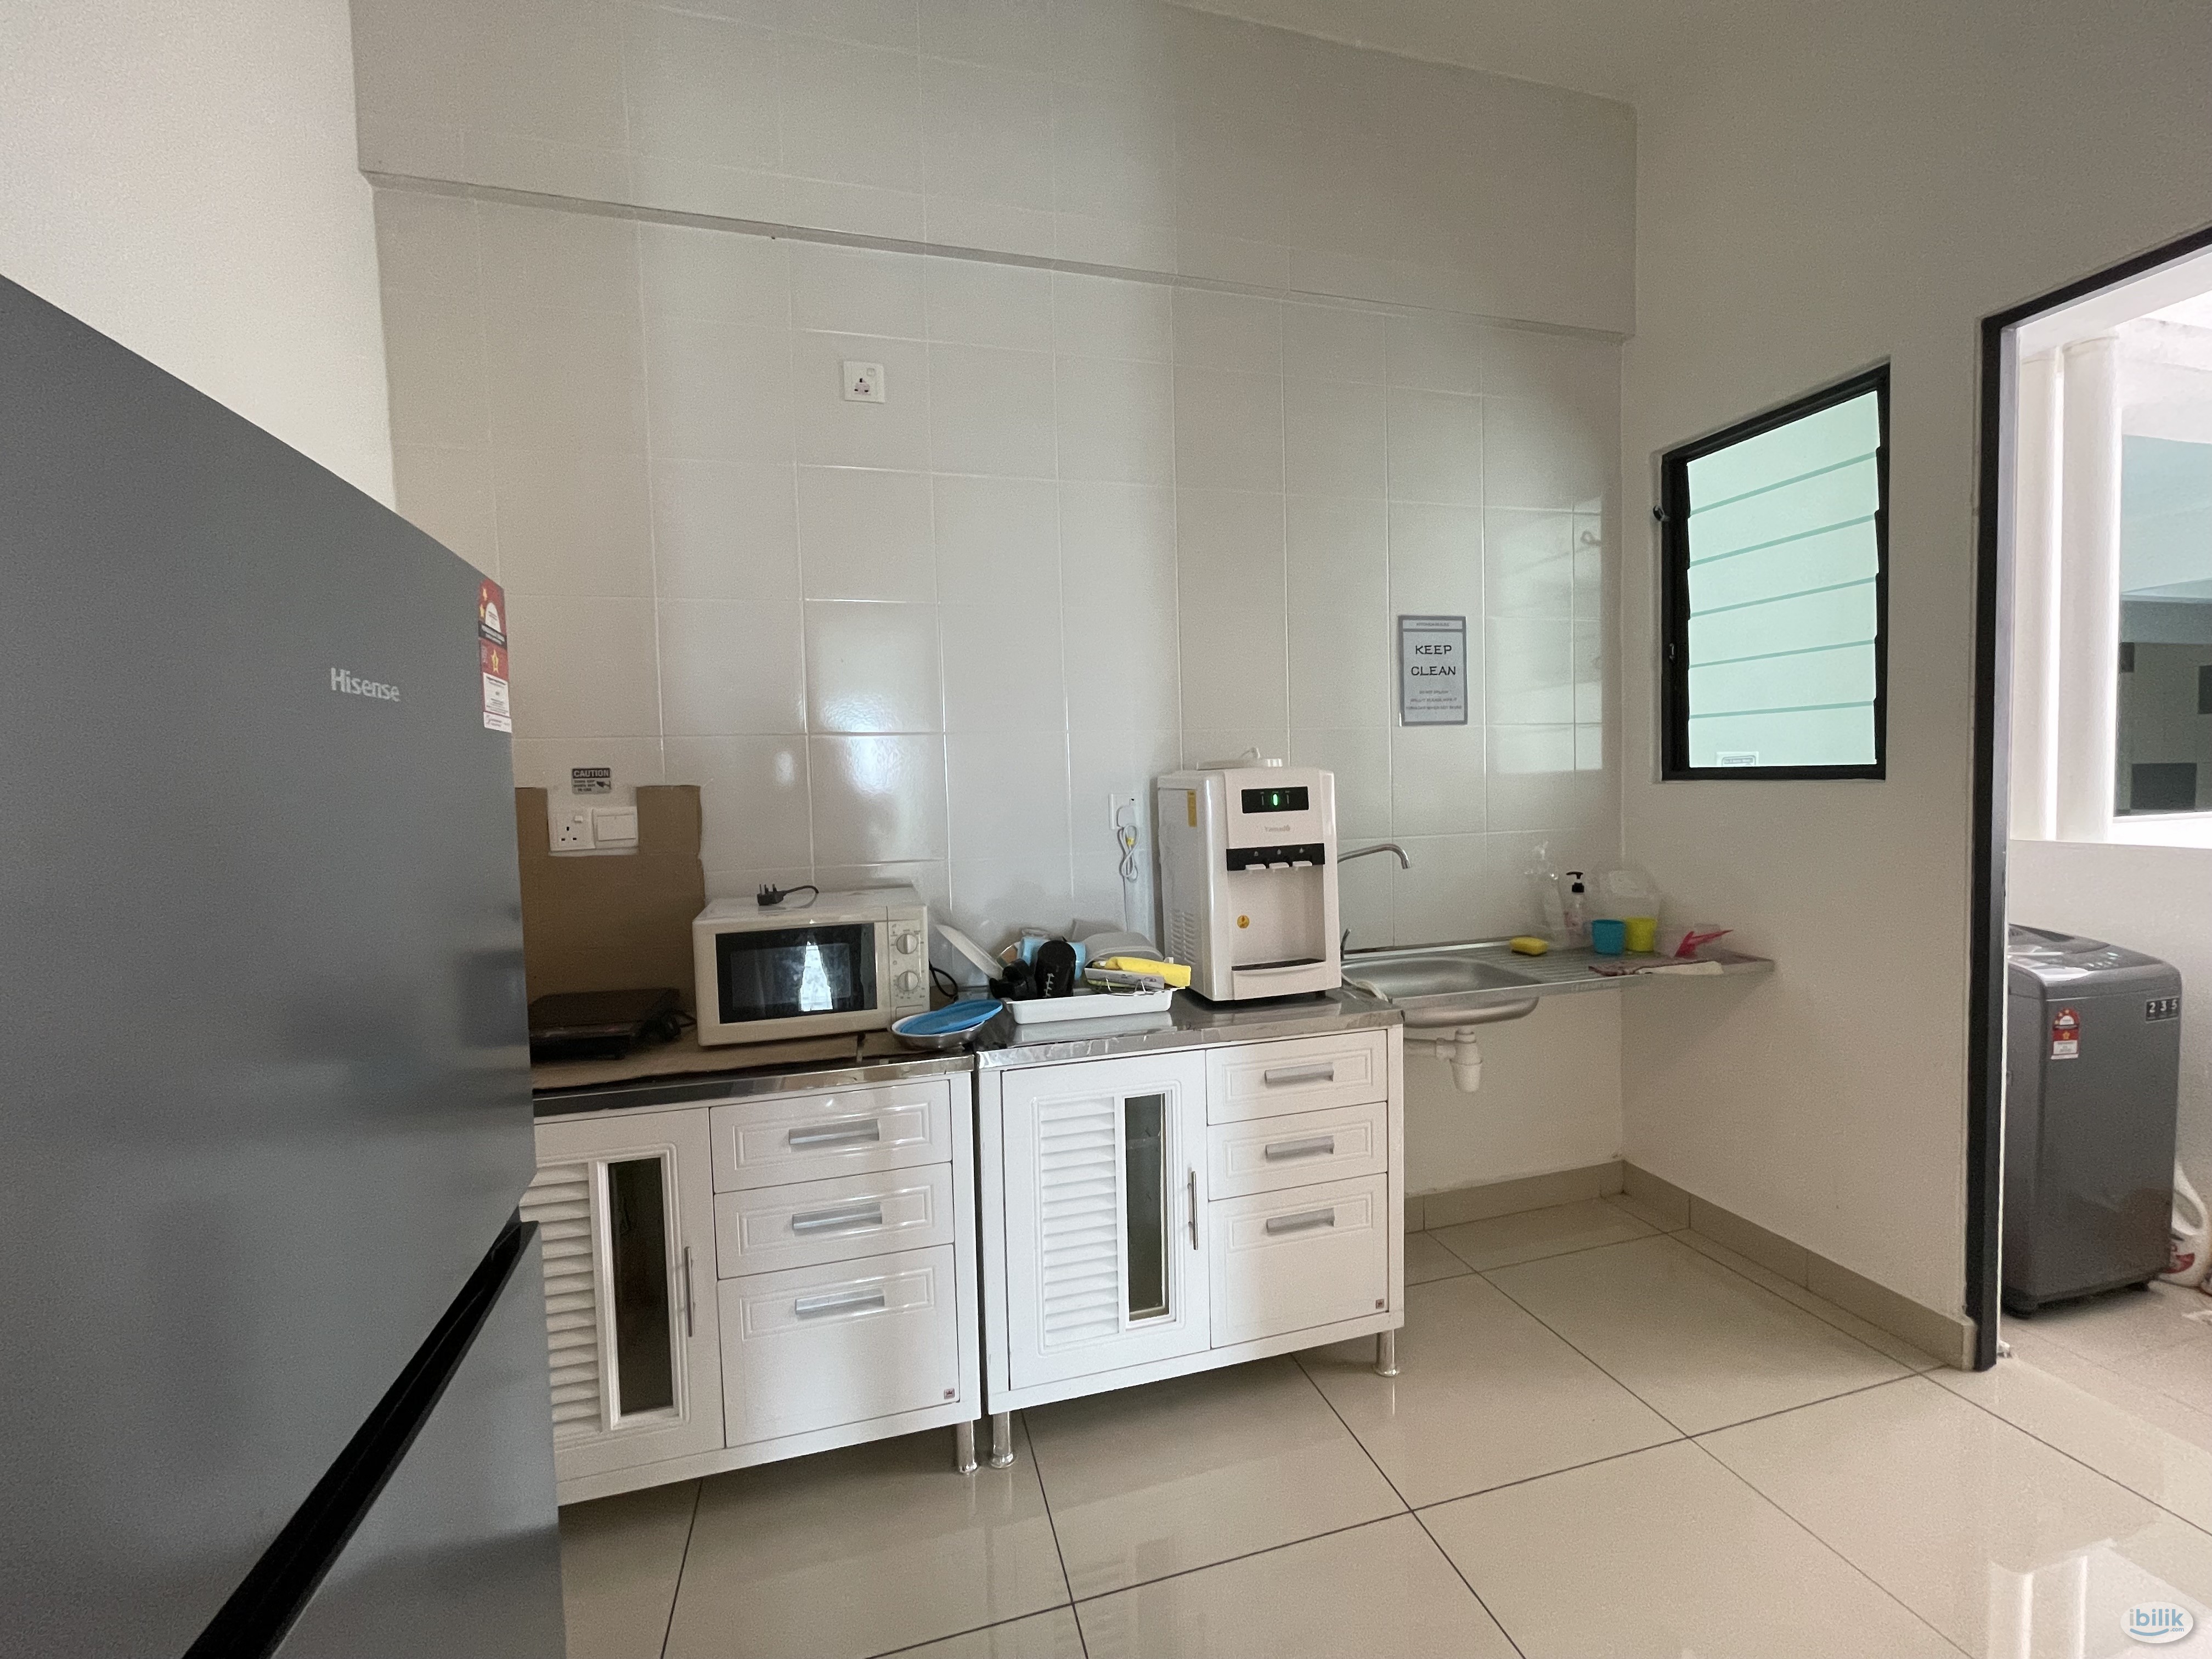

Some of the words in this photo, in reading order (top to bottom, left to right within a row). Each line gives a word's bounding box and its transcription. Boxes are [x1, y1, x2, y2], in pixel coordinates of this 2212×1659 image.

[1415, 645, 1452, 655] KEEP
[1411, 666, 1456, 676] CLEAN
[330, 667, 401, 702] Hisense
[573, 769, 609, 777] CAUTION
